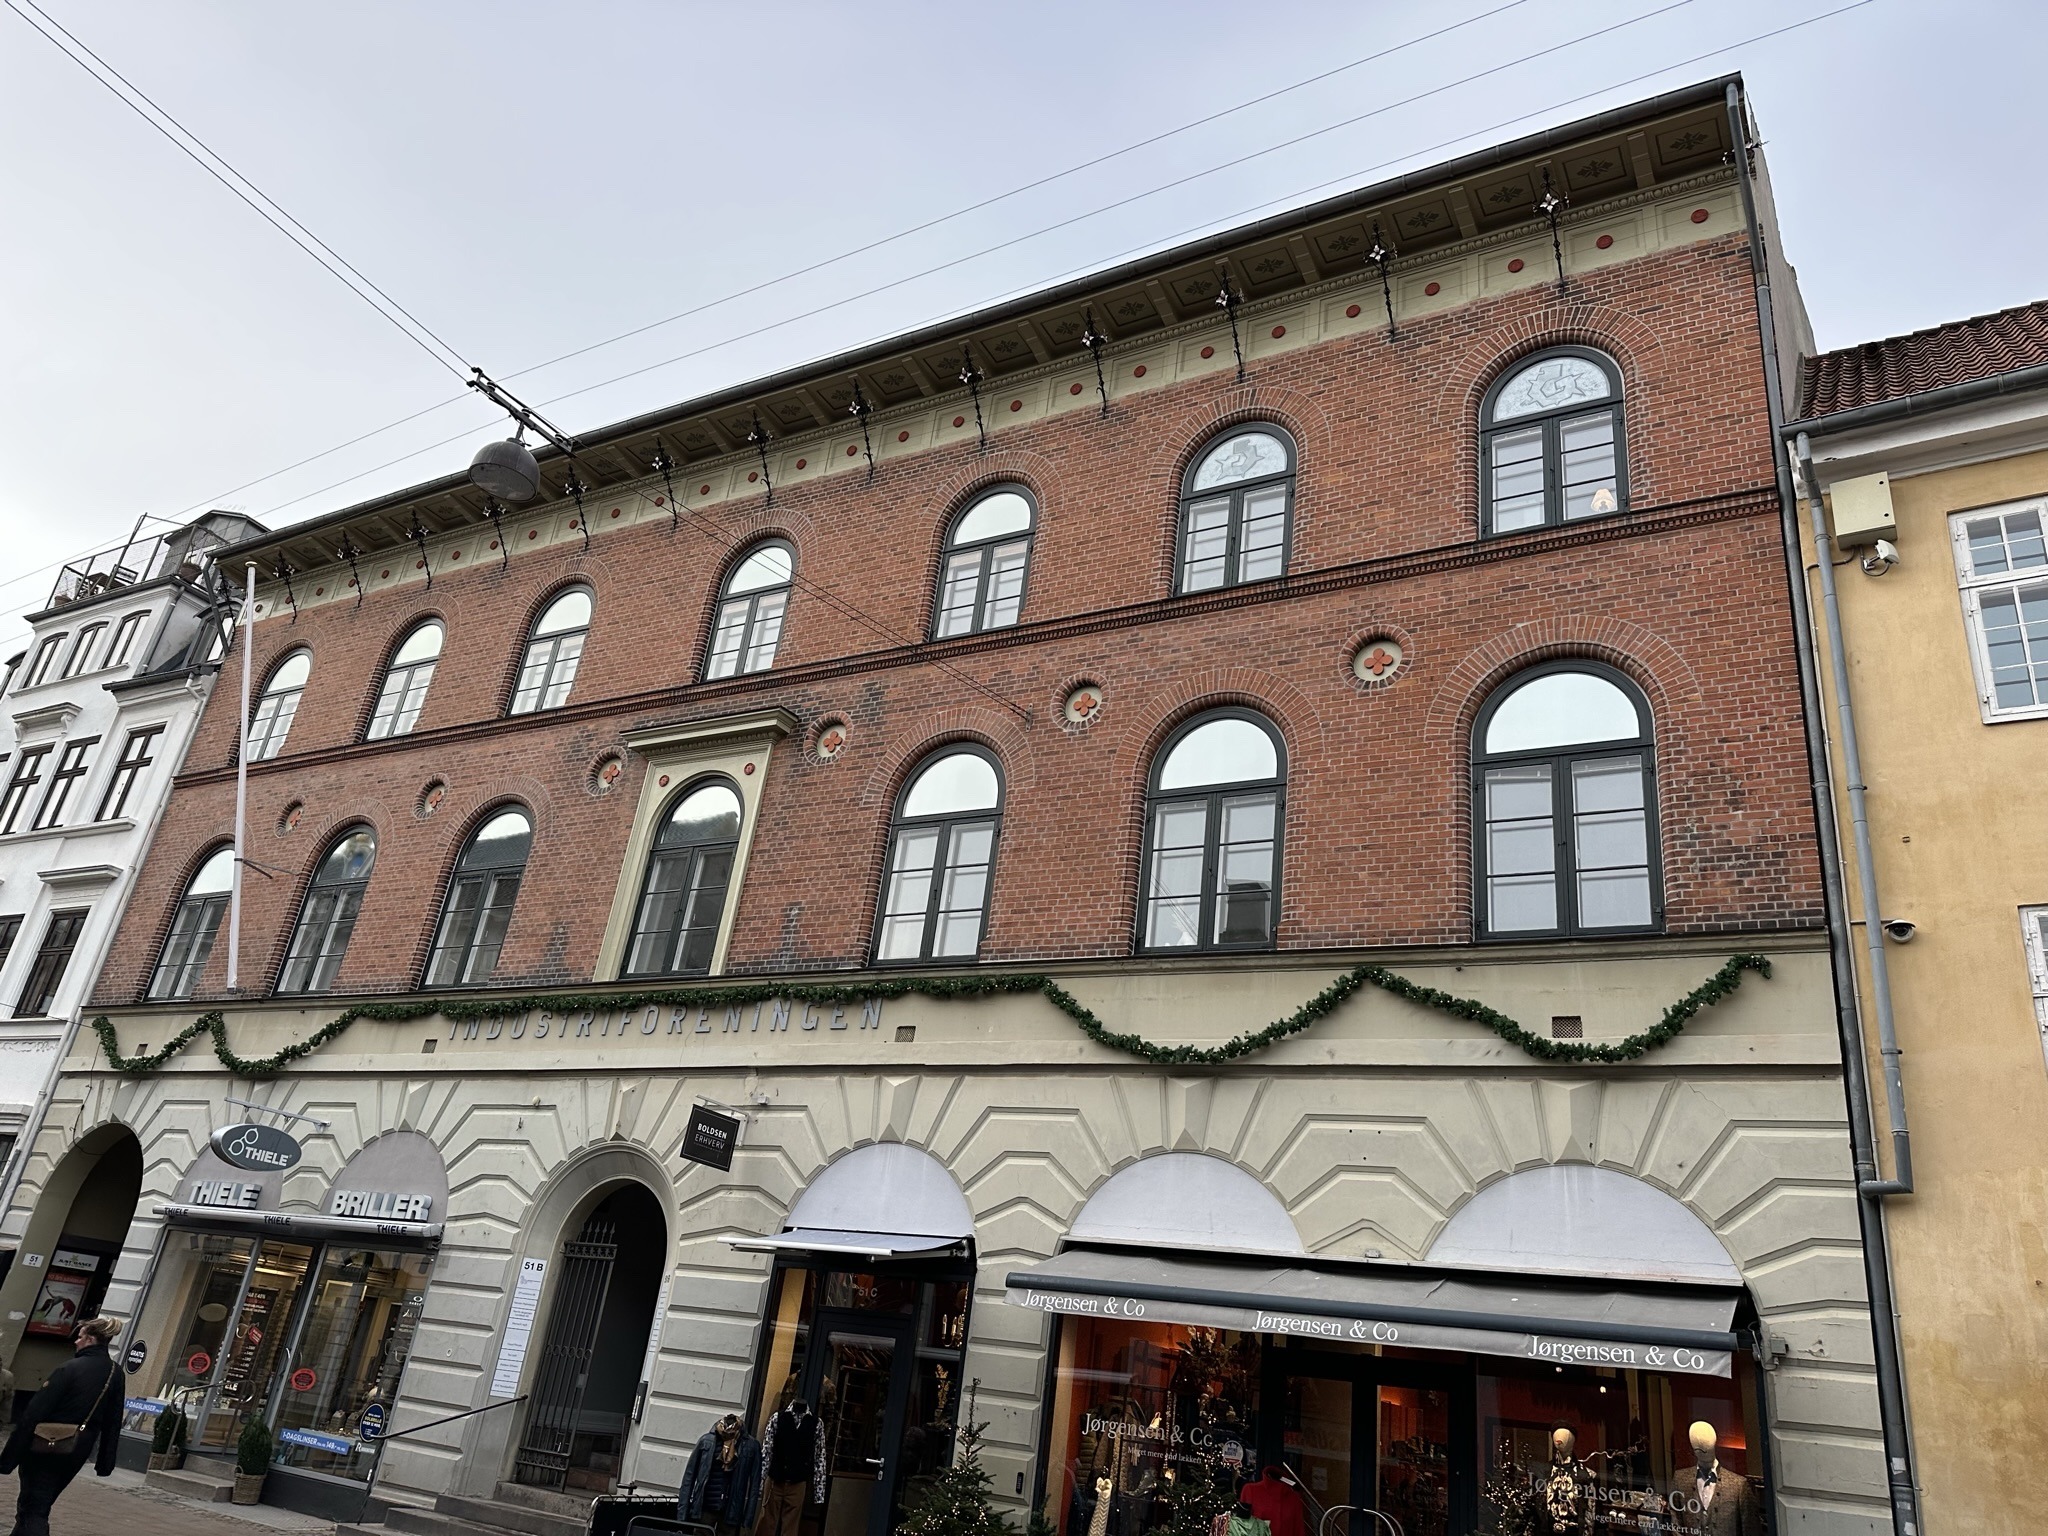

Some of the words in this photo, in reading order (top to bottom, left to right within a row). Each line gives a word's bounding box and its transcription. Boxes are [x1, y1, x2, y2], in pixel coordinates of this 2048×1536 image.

[448, 998, 883, 1041] INDUSTRIFORENINGEN
[697, 1123, 728, 1140] BOLDSEN
[694, 1133, 726, 1150] ERHVERV
[244, 1145, 290, 1167] THIELE
[188, 1180, 262, 1209] THIELE
[164, 1207, 189, 1218] THIELE
[330, 1189, 433, 1221] BRILLER
[263, 1215, 292, 1226] THIELE
[376, 1224, 408, 1235] THIELE
[29, 1255, 39, 1263] 51
[524, 1261, 535, 1271] 51
[536, 1263, 544, 1271] B
[858, 1287, 869, 1297] 51
[870, 1287, 878, 1297] C
[1021, 1289, 1098, 1314] Jørgensen
[1103, 1296, 1119, 1314] &
[1123, 1297, 1145, 1317] Co
[1252, 1310, 1342, 1337] Jørgensen
[1349, 1319, 1367, 1339] &
[1372, 1321, 1399, 1342] Co
[1528, 1335, 1636, 1364] Jørgensen
[1645, 1345, 1666, 1366] &
[1673, 1348, 1705, 1370] Co
[1082, 1413, 1166, 1439] Jørgensen
[1170, 1424, 1184, 1443] &
[282, 1431, 318, 1445] 1-DAGSLINSER
[1147, 1450, 1164, 1459] mere
[1525, 1471, 1634, 1502] Jøgensen
[1669, 1490, 1702, 1514] Co
[1614, 1516, 1637, 1528] mere
[1657, 1520, 1688, 1534] lækkert
